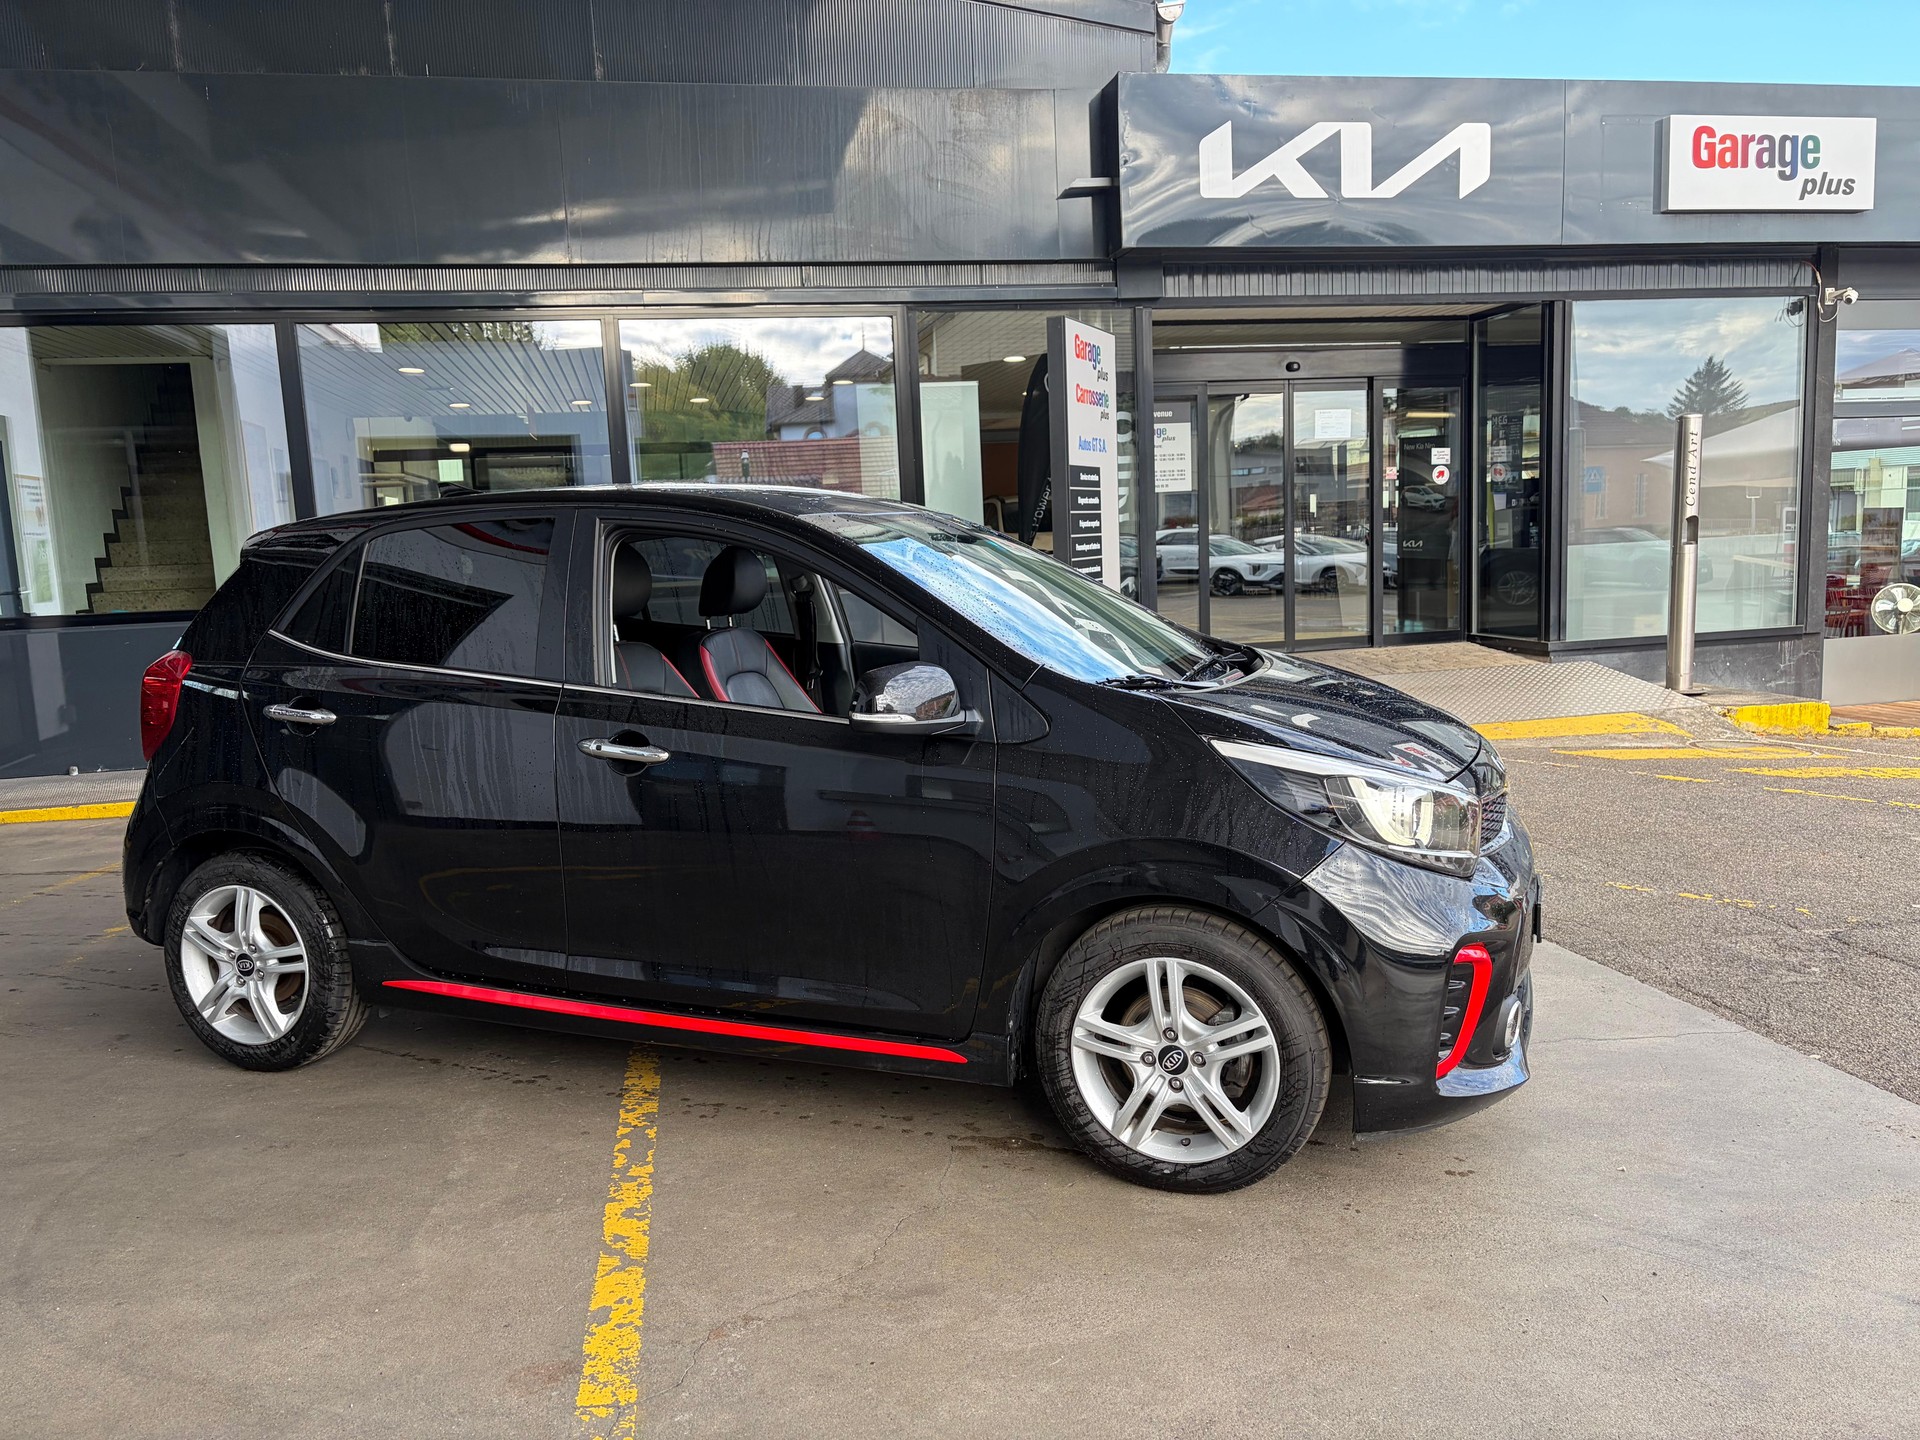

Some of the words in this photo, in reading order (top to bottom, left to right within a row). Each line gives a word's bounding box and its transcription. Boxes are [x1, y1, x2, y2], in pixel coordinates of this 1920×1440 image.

[1199, 119, 1492, 200] KIA
[1692, 125, 1821, 181] Garage
[1798, 171, 1856, 201] plus
[1074, 333, 1102, 370] Garage
[1097, 367, 1109, 382] plus
[1075, 383, 1110, 409] Carrosserie
[1100, 409, 1110, 421] plus
[1078, 435, 1092, 452] Autos
[1092, 437, 1098, 452] GT
[1098, 438, 1107, 453] S.A.
[1685, 431, 1698, 506] Cend'Art
[1402, 539, 1423, 548] KIA
[238, 961, 252, 970] KIA
[1164, 1052, 1182, 1069] KIA
